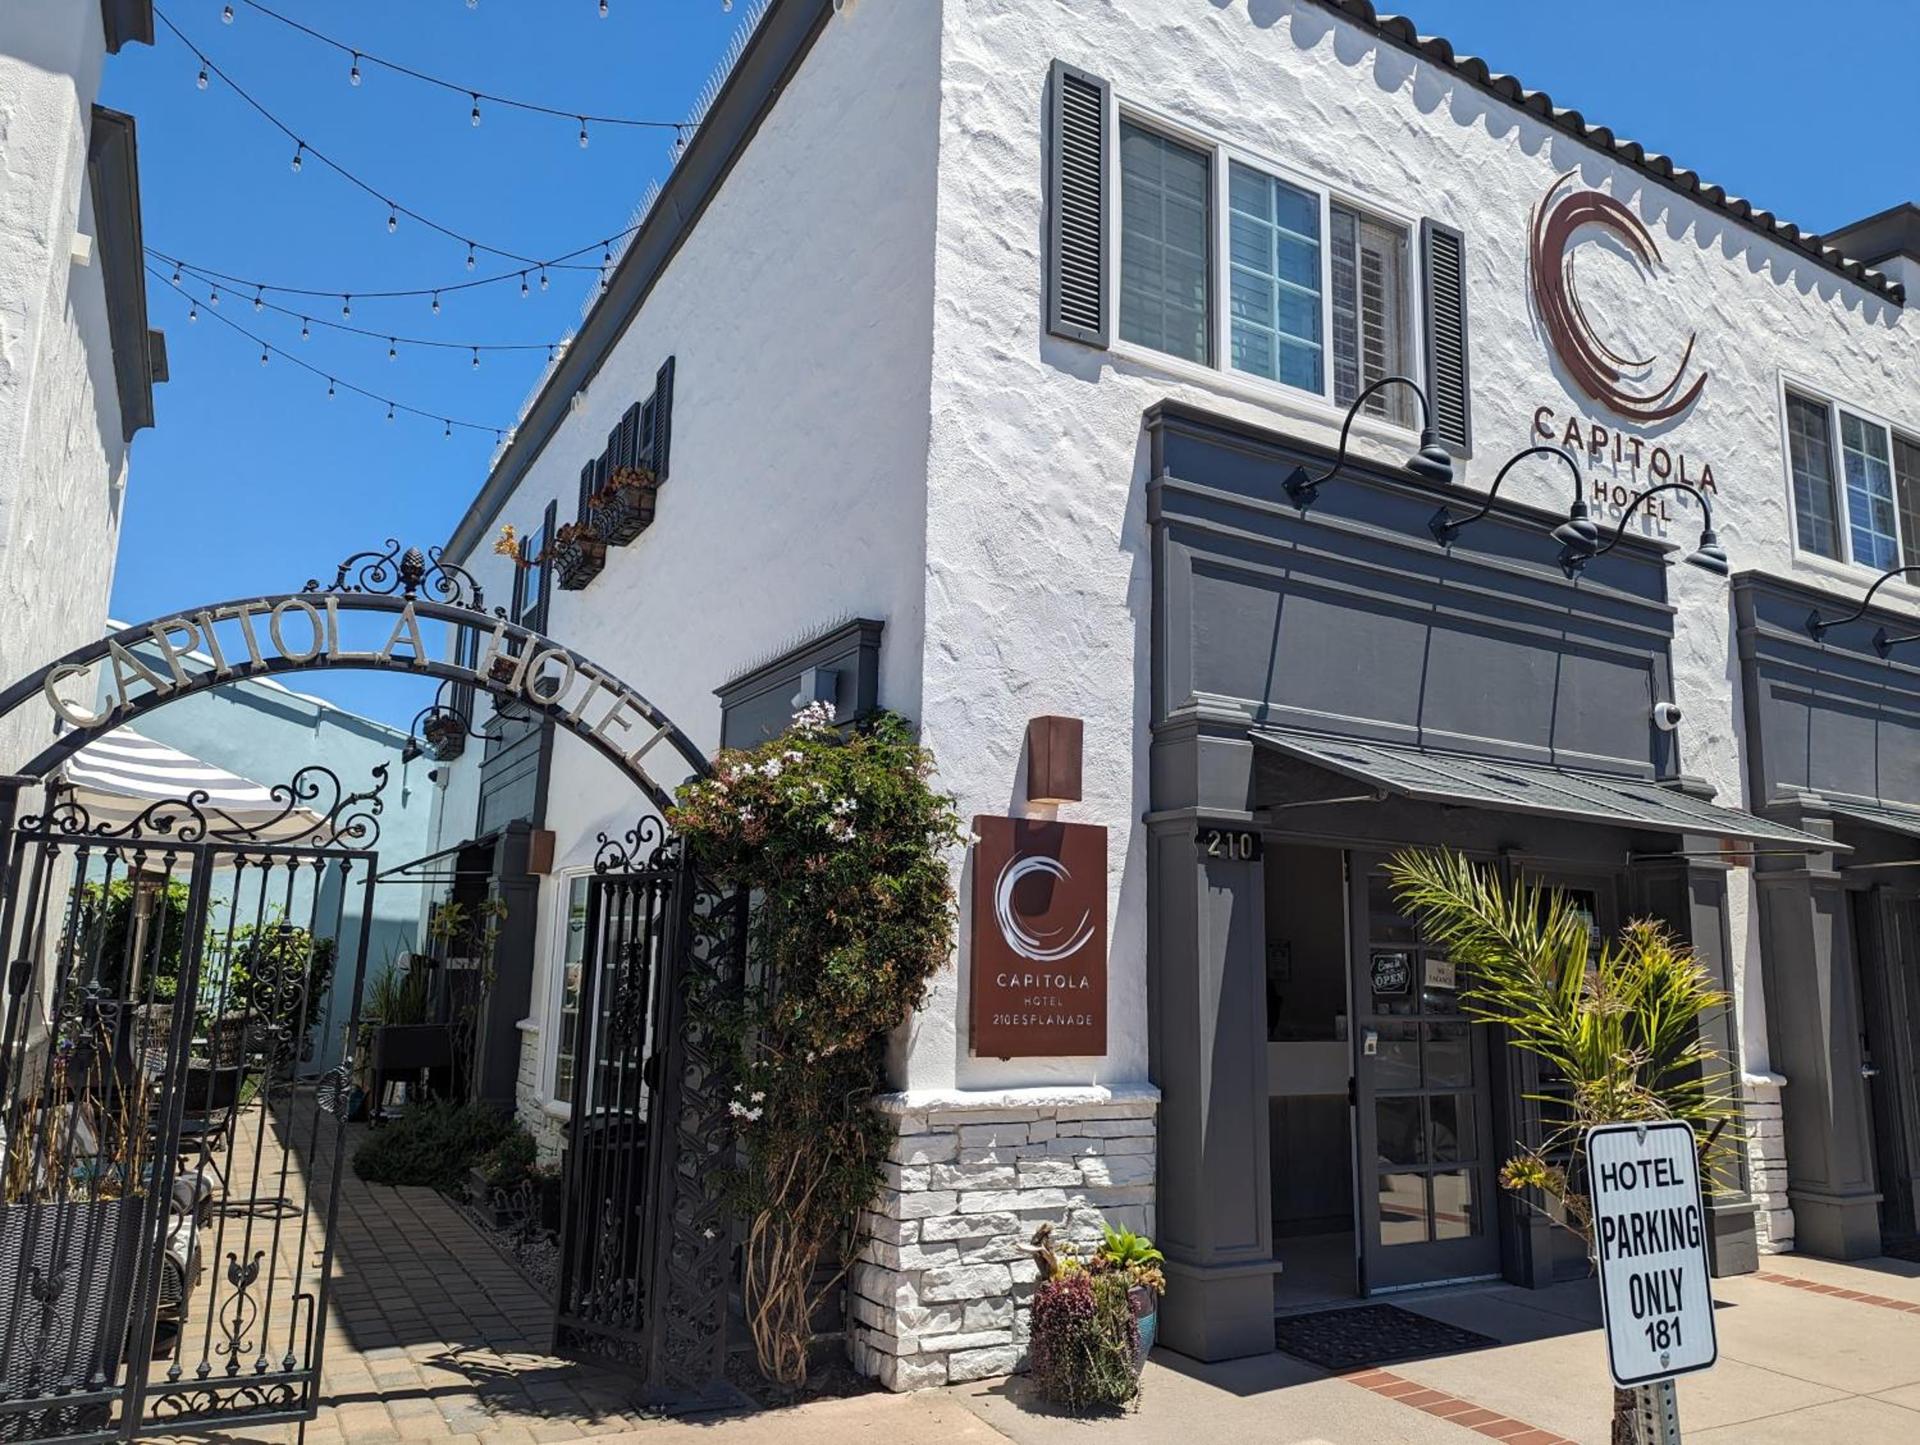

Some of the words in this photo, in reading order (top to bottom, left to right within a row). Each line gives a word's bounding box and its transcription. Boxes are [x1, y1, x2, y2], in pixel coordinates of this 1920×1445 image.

[1534, 406, 1718, 495] CAPITOLA
[1594, 479, 1672, 522] HOTEL
[44, 596, 430, 730] CAPITOLA
[475, 618, 673, 795] HOTEL
[1207, 829, 1253, 859] 210
[996, 972, 1090, 989] CAPITOLA
[1375, 971, 1406, 986] OPEN
[1023, 995, 1063, 1007] HOTEL
[1600, 1157, 1684, 1193] HOTEL
[1601, 1204, 1701, 1261] PARKING
[1629, 1267, 1683, 1320] ONLY
[1644, 1316, 1683, 1352] 181
